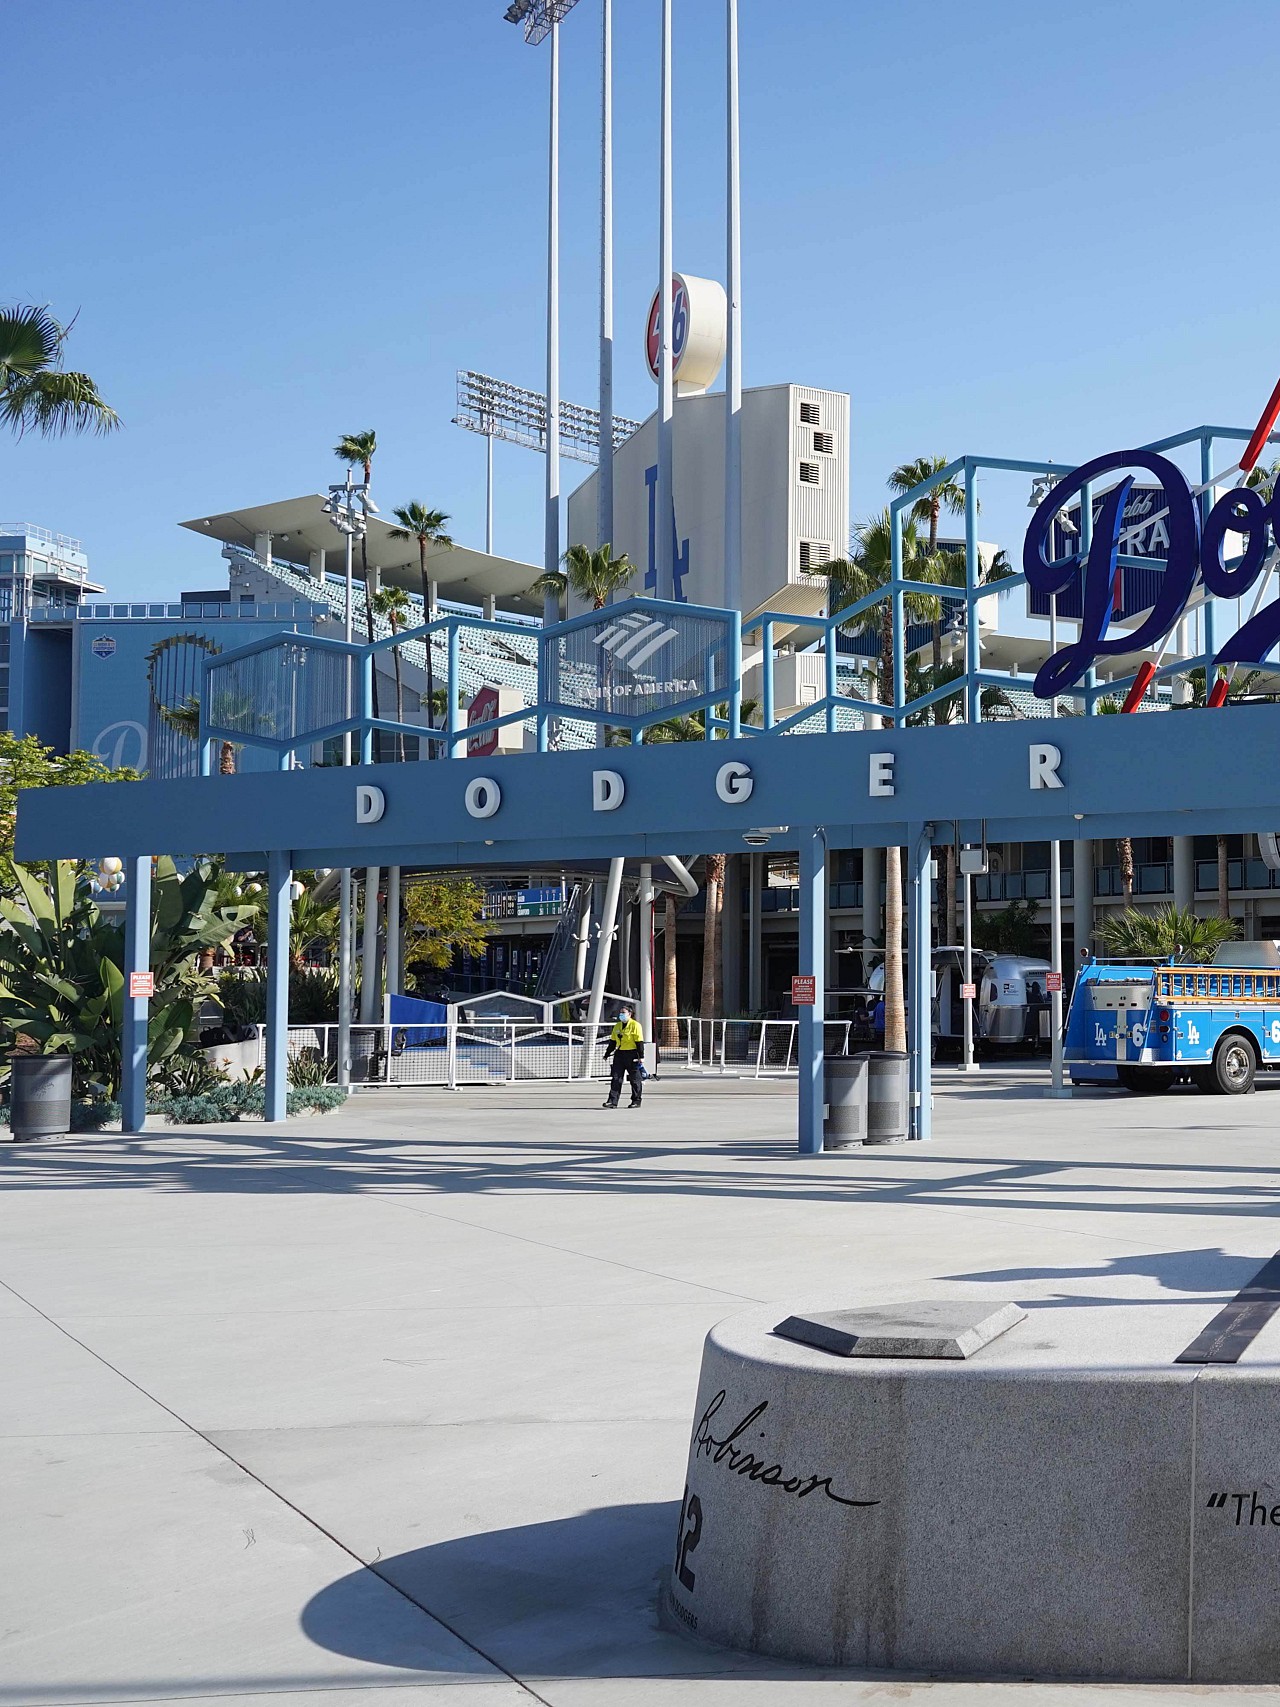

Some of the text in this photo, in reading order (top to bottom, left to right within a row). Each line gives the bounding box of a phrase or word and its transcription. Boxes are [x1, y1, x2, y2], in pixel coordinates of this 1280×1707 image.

[356, 743, 1065, 824] DODGER
[1094, 1022, 1148, 1047] LA 6
[1187, 1020, 1200, 1045] LA
[693, 1389, 882, 1507] Robinson
[675, 1484, 703, 1593] 2
